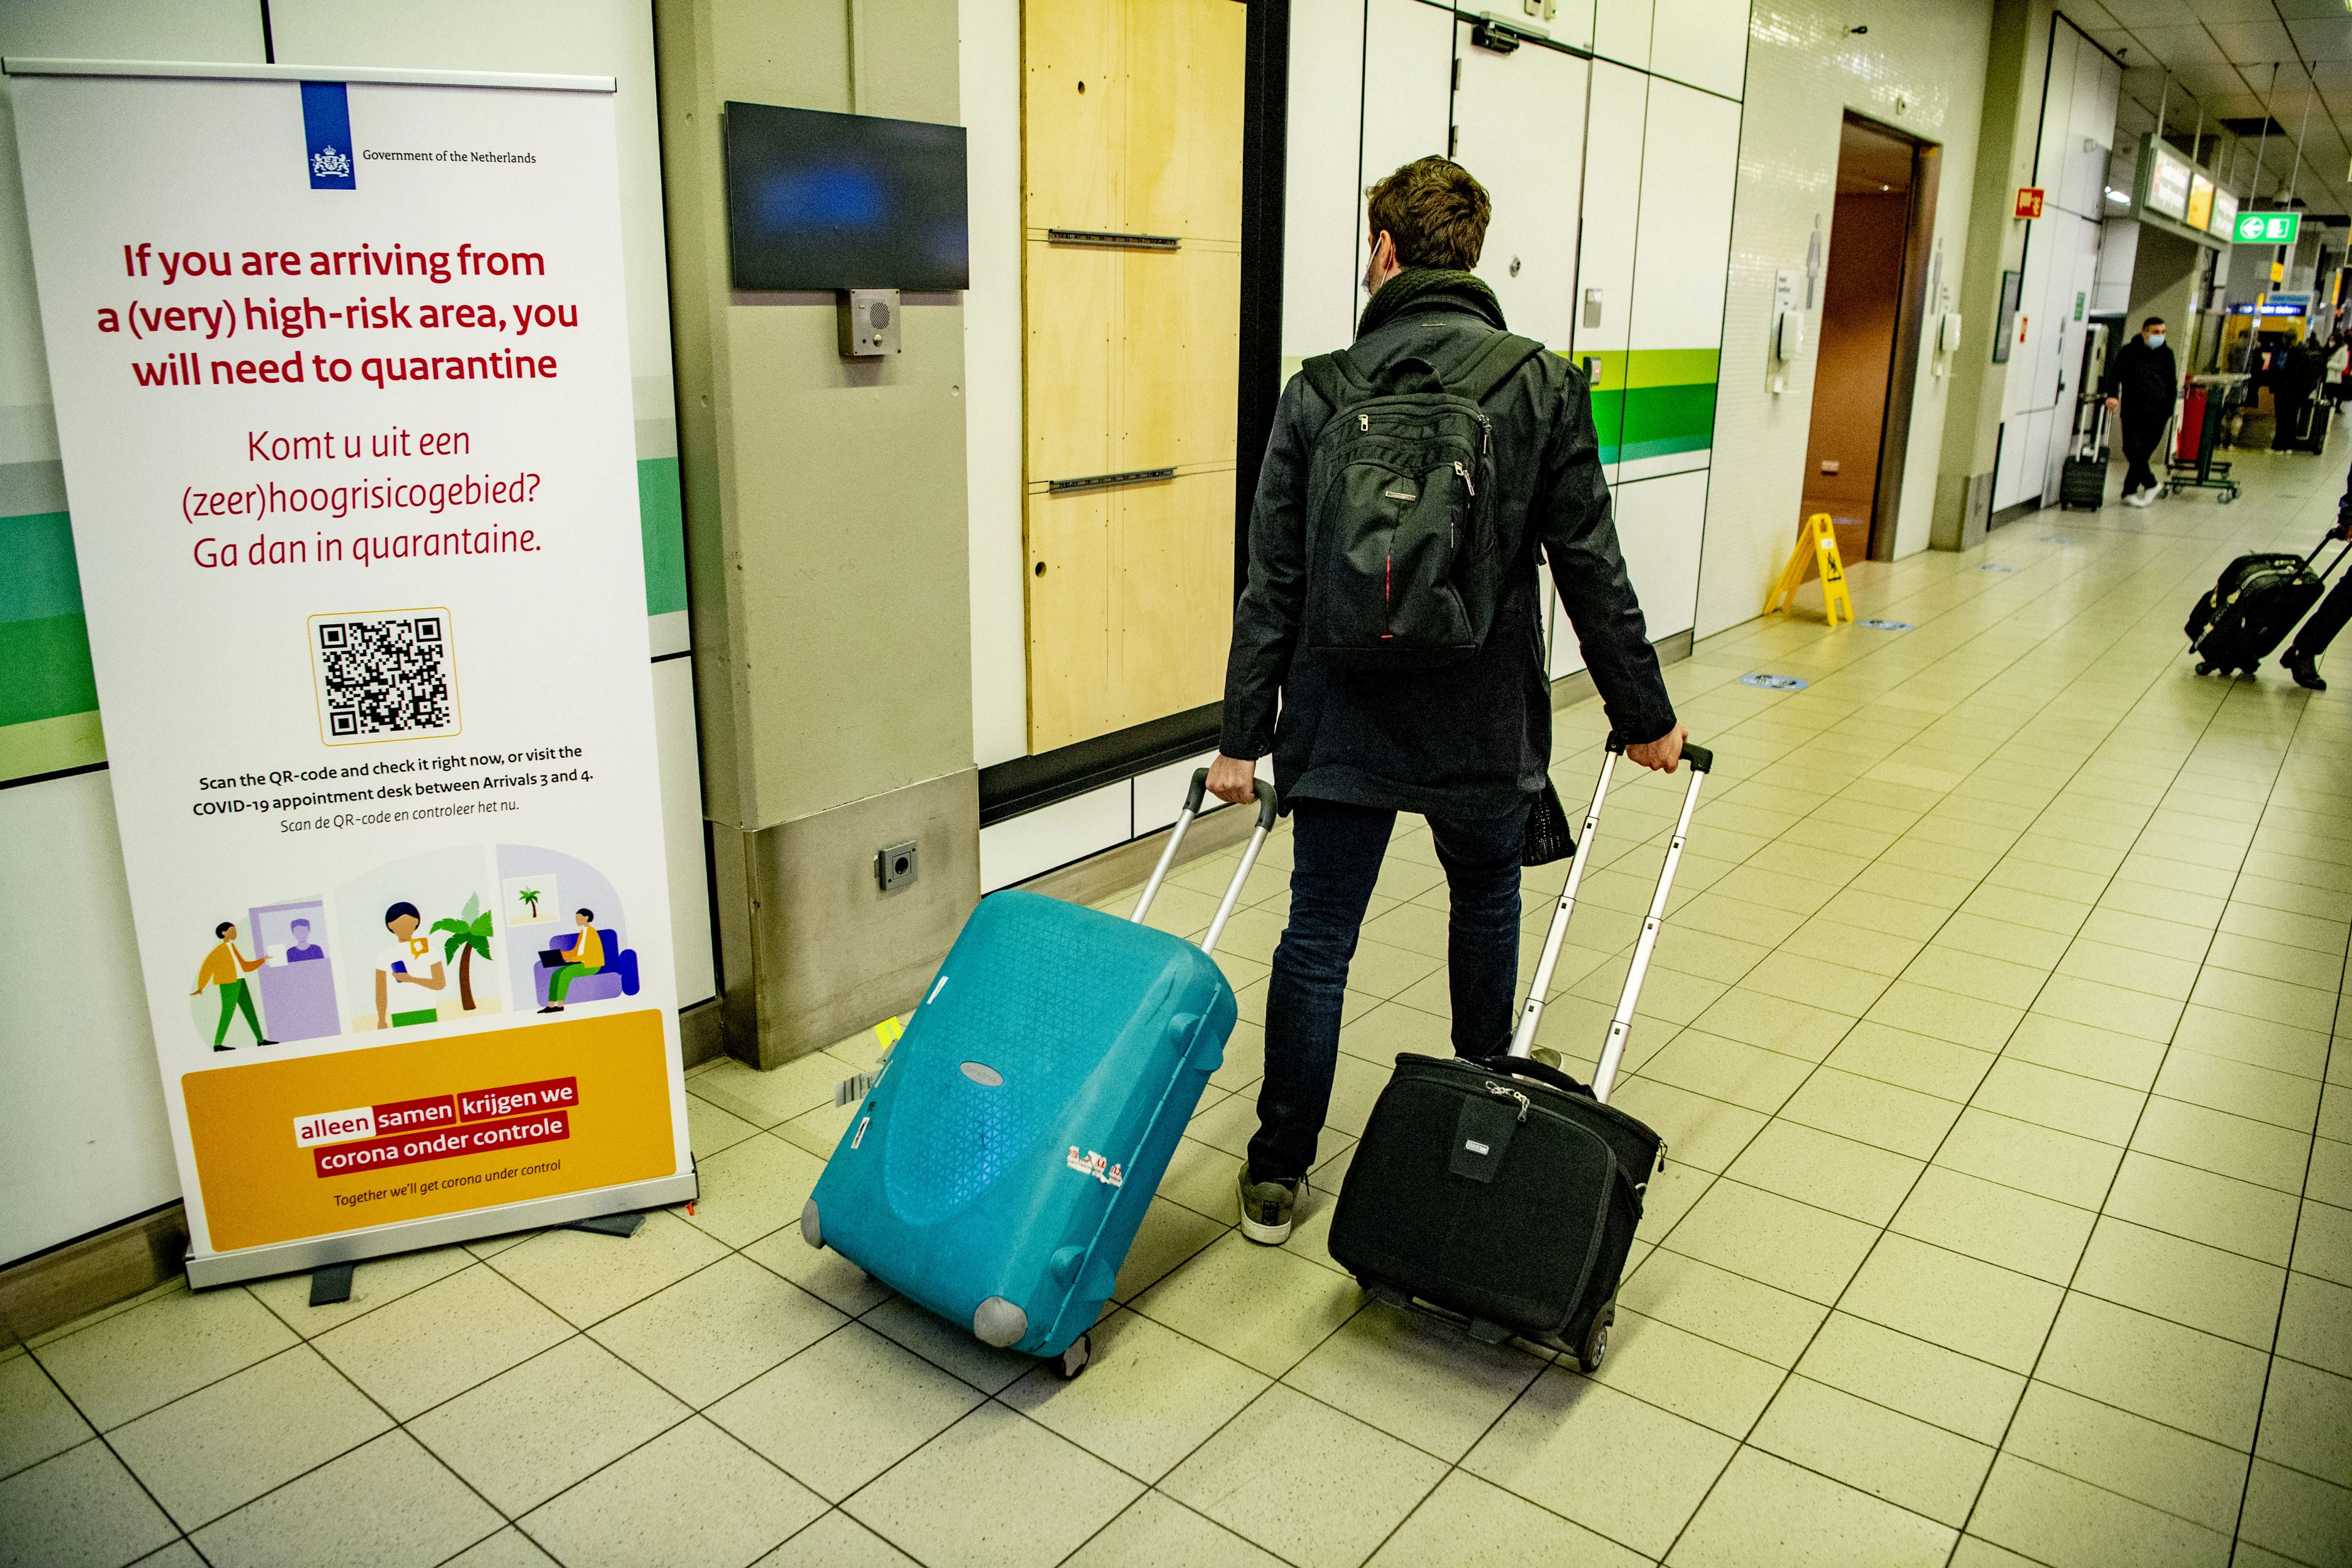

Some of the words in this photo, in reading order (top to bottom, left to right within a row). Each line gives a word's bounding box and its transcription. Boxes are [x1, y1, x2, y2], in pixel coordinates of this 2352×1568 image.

[363, 149, 433, 161] Government
[435, 150, 447, 161] of
[450, 151, 467, 162] the
[470, 152, 536, 163] Netherlands
[124, 243, 151, 277] If
[158, 252, 232, 285] you
[242, 251, 301, 276] are
[310, 243, 452, 284] arriving
[456, 243, 545, 276] from
[98, 308, 120, 333] a
[129, 300, 236, 340] (very)
[244, 296, 412, 339] high-risk
[419, 304, 507, 332] area,
[513, 304, 578, 336] you
[132, 352, 201, 386] will
[211, 350, 304, 385] need
[312, 355, 353, 383] to
[361, 347, 557, 390] quarantine
[249, 431, 336, 461] Komt
[344, 435, 361, 459] u
[372, 426, 412, 458] uit
[419, 432, 470, 456] een
[183, 472, 541, 524] (zeer)hoogrisicogebied?
[194, 538, 238, 568] Ga
[248, 533, 306, 566] dan
[317, 531, 342, 562] in
[352, 523, 541, 567] quarantaine.
[199, 777, 236, 791] Scan
[239, 773, 266, 787] the
[269, 766, 337, 786] QR-code
[341, 763, 369, 778] and
[372, 760, 415, 775] check
[418, 760, 429, 771] it
[432, 755, 467, 772] right
[470, 755, 505, 766] now,
[508, 753, 523, 763] or
[526, 748, 556, 761] visit
[559, 745, 582, 758] the
[193, 799, 270, 816] COVID-19
[273, 789, 374, 811] appointment
[377, 784, 412, 799] desk
[415, 780, 480, 796] between
[483, 773, 537, 789] Arrivals
[540, 774, 548, 786] 3
[551, 769, 578, 783] and
[581, 771, 593, 782] 4.
[281, 820, 311, 833] Scan
[315, 816, 330, 829] de
[333, 810, 391, 829] QR-code
[394, 811, 409, 822] en
[412, 804, 475, 820] controleer
[478, 801, 497, 813] het
[500, 801, 519, 811] nu.
[302, 1118, 369, 1139] alleen
[378, 1105, 452, 1128] samen
[462, 1092, 537, 1115] krijgen
[540, 1087, 573, 1103] we
[321, 1146, 399, 1169] corona
[404, 1134, 469, 1156] onder
[473, 1118, 562, 1145] controle
[333, 1189, 388, 1208] Together
[390, 1182, 417, 1197] we’ll
[420, 1180, 439, 1196] get
[441, 1174, 482, 1189] corona
[484, 1167, 518, 1182] under
[521, 1159, 561, 1176] control
